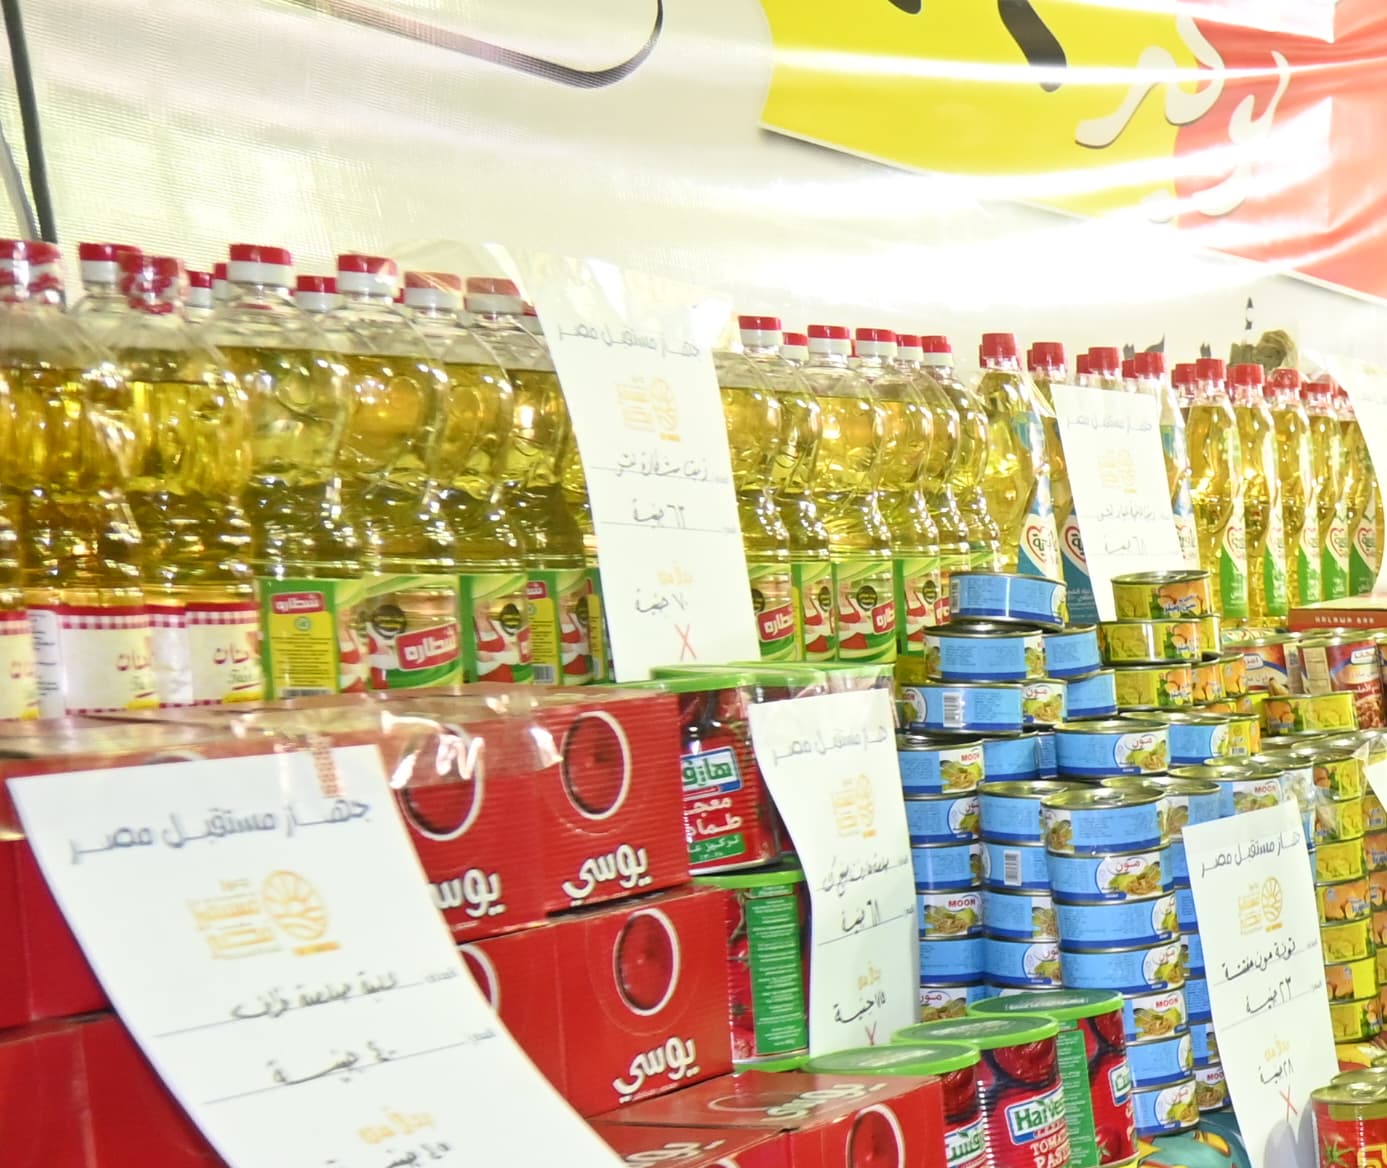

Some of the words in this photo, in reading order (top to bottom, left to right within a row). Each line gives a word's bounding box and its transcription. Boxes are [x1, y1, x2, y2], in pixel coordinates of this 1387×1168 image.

[163, 804, 277, 850] مستقبل
[285, 798, 371, 839] جهاز
[69, 825, 154, 866] مصر
[1200, 851, 1233, 878] مصر
[1234, 834, 1275, 867] مستقبل
[560, 843, 653, 907] يوسي
[612, 1036, 702, 1103] يوسي
[1206, 1071, 1225, 1082] MOO
